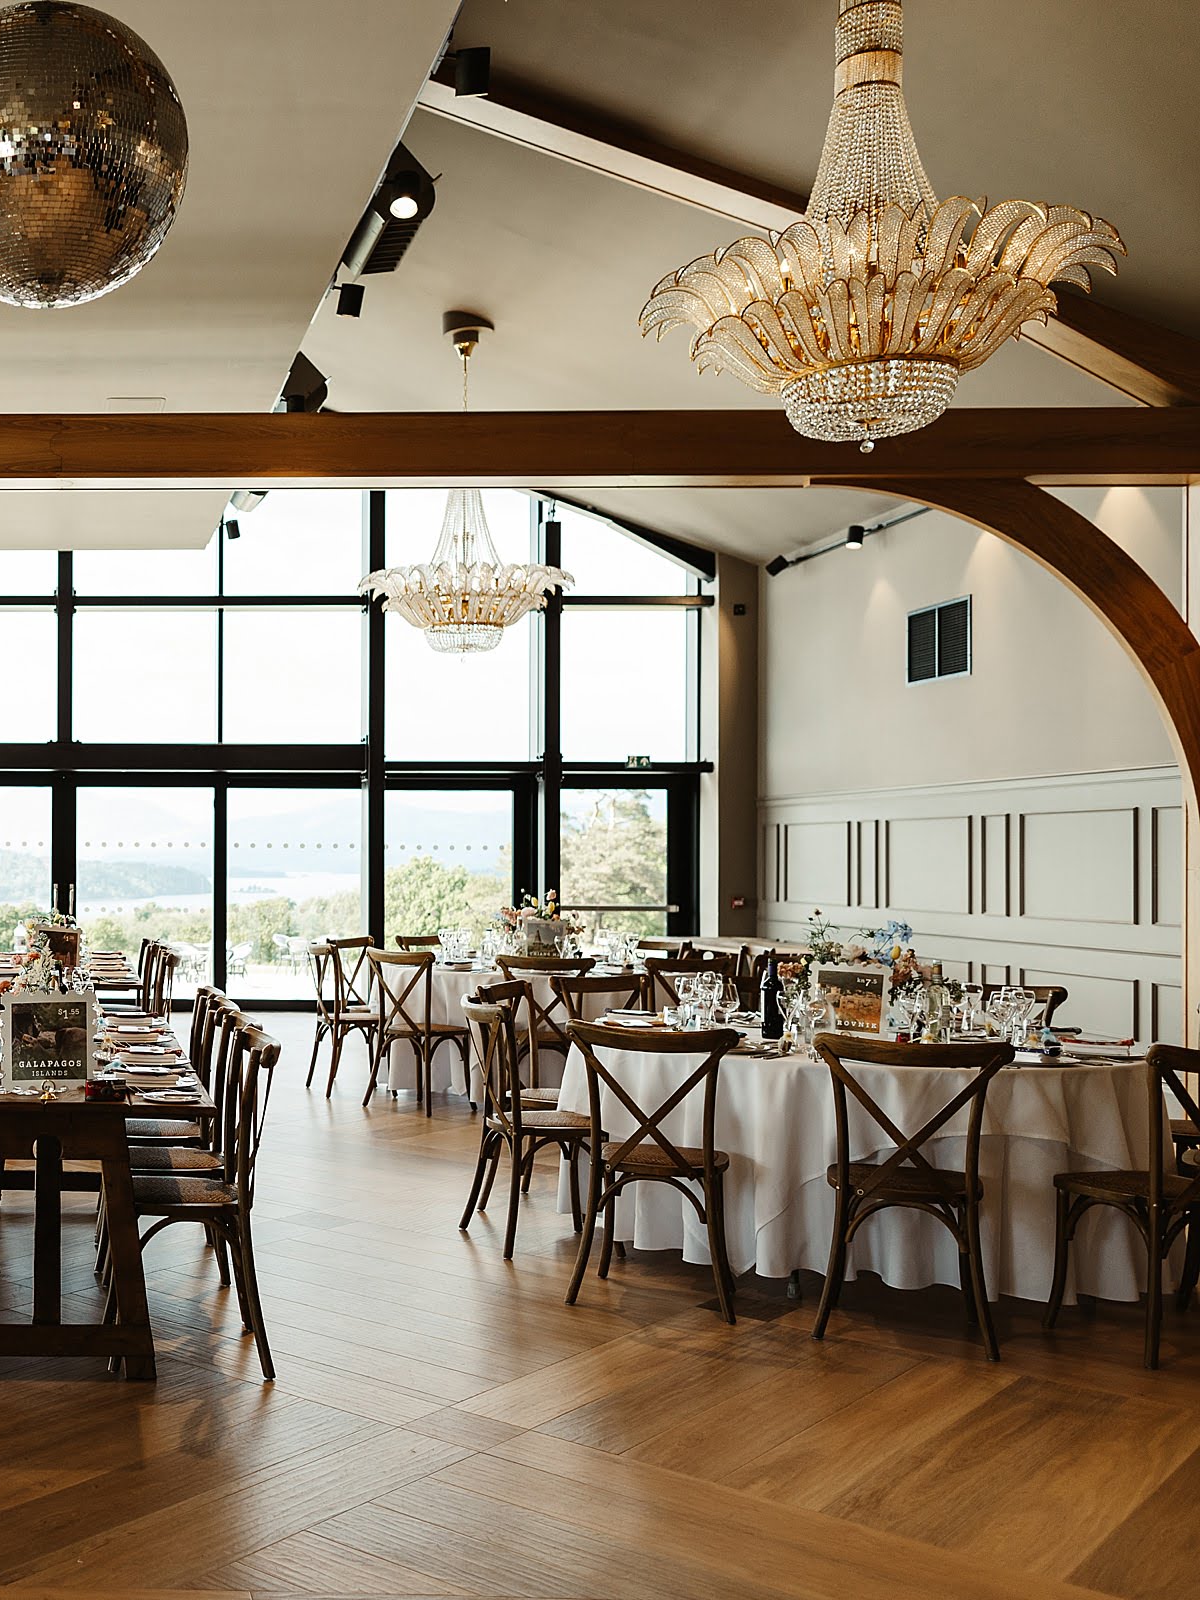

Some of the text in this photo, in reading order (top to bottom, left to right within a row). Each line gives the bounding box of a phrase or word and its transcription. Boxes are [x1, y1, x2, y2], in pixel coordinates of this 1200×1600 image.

[57, 1008, 80, 1020] $1.55
[836, 1019, 877, 1029] ROVNIK
[18, 1060, 82, 1068] GALAPAGOS
